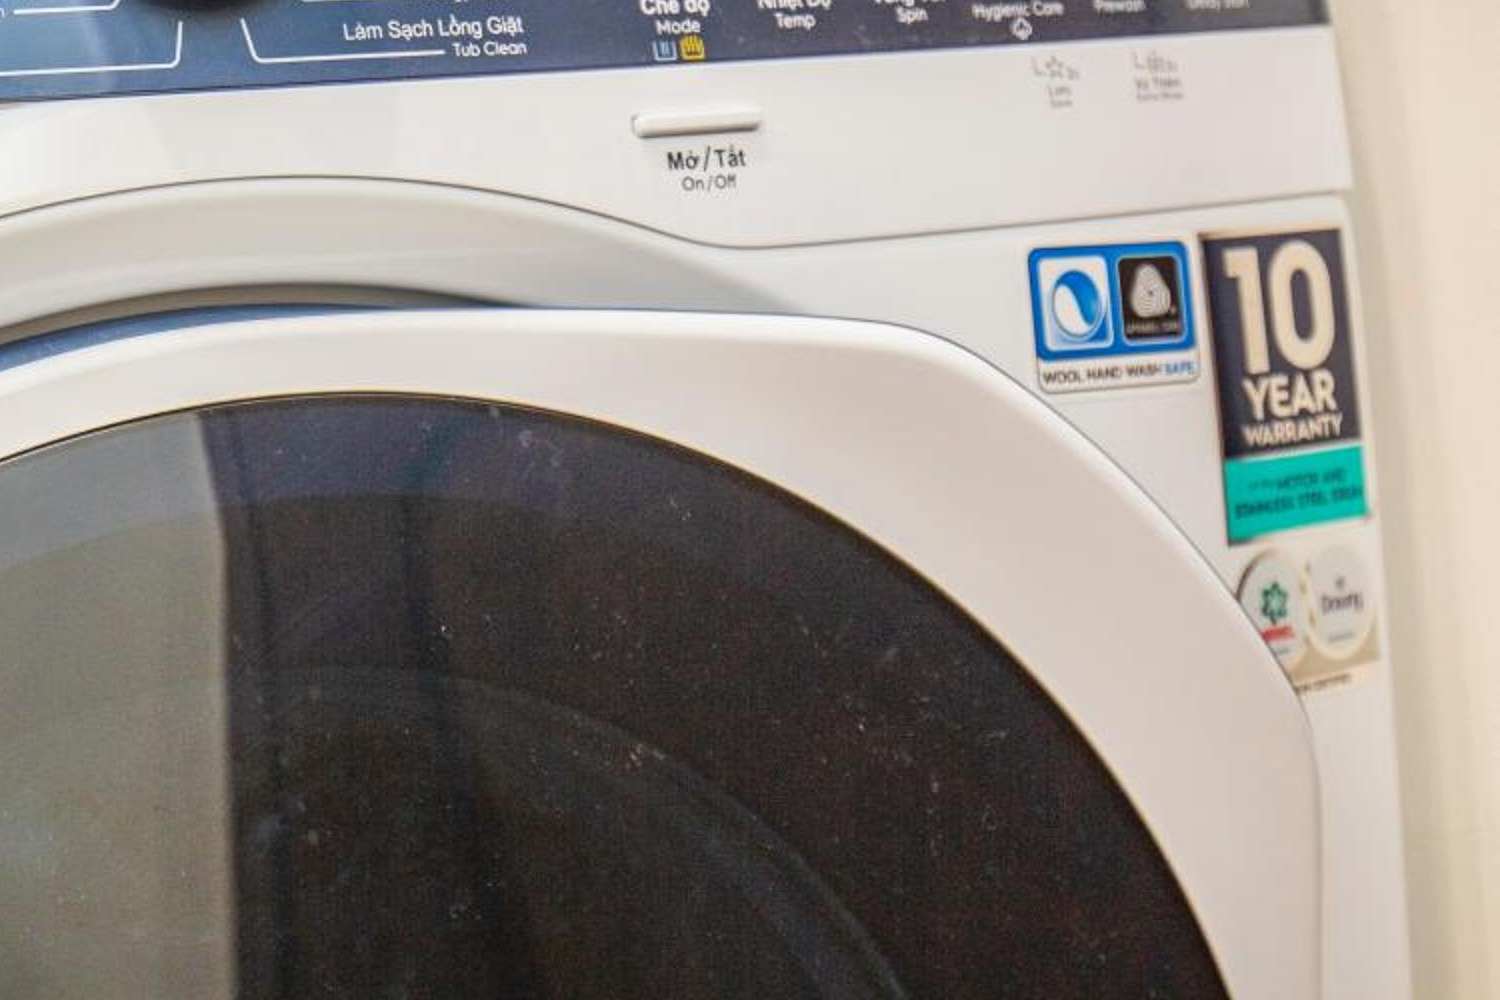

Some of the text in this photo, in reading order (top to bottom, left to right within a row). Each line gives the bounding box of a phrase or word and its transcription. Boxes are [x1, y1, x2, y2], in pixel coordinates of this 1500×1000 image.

[774, 13, 816, 29] Temp
[895, 7, 928, 23] Spin
[343, 21, 383, 40] Làm
[387, 18, 434, 40] Sạch
[655, 20, 701, 35] Mode
[452, 40, 527, 57] Tub Clean
[681, 173, 736, 192] On/Off
[1222, 239, 1336, 376] 10
[1241, 368, 1338, 421] YEAR
[1241, 413, 1344, 446] WARRANTY
